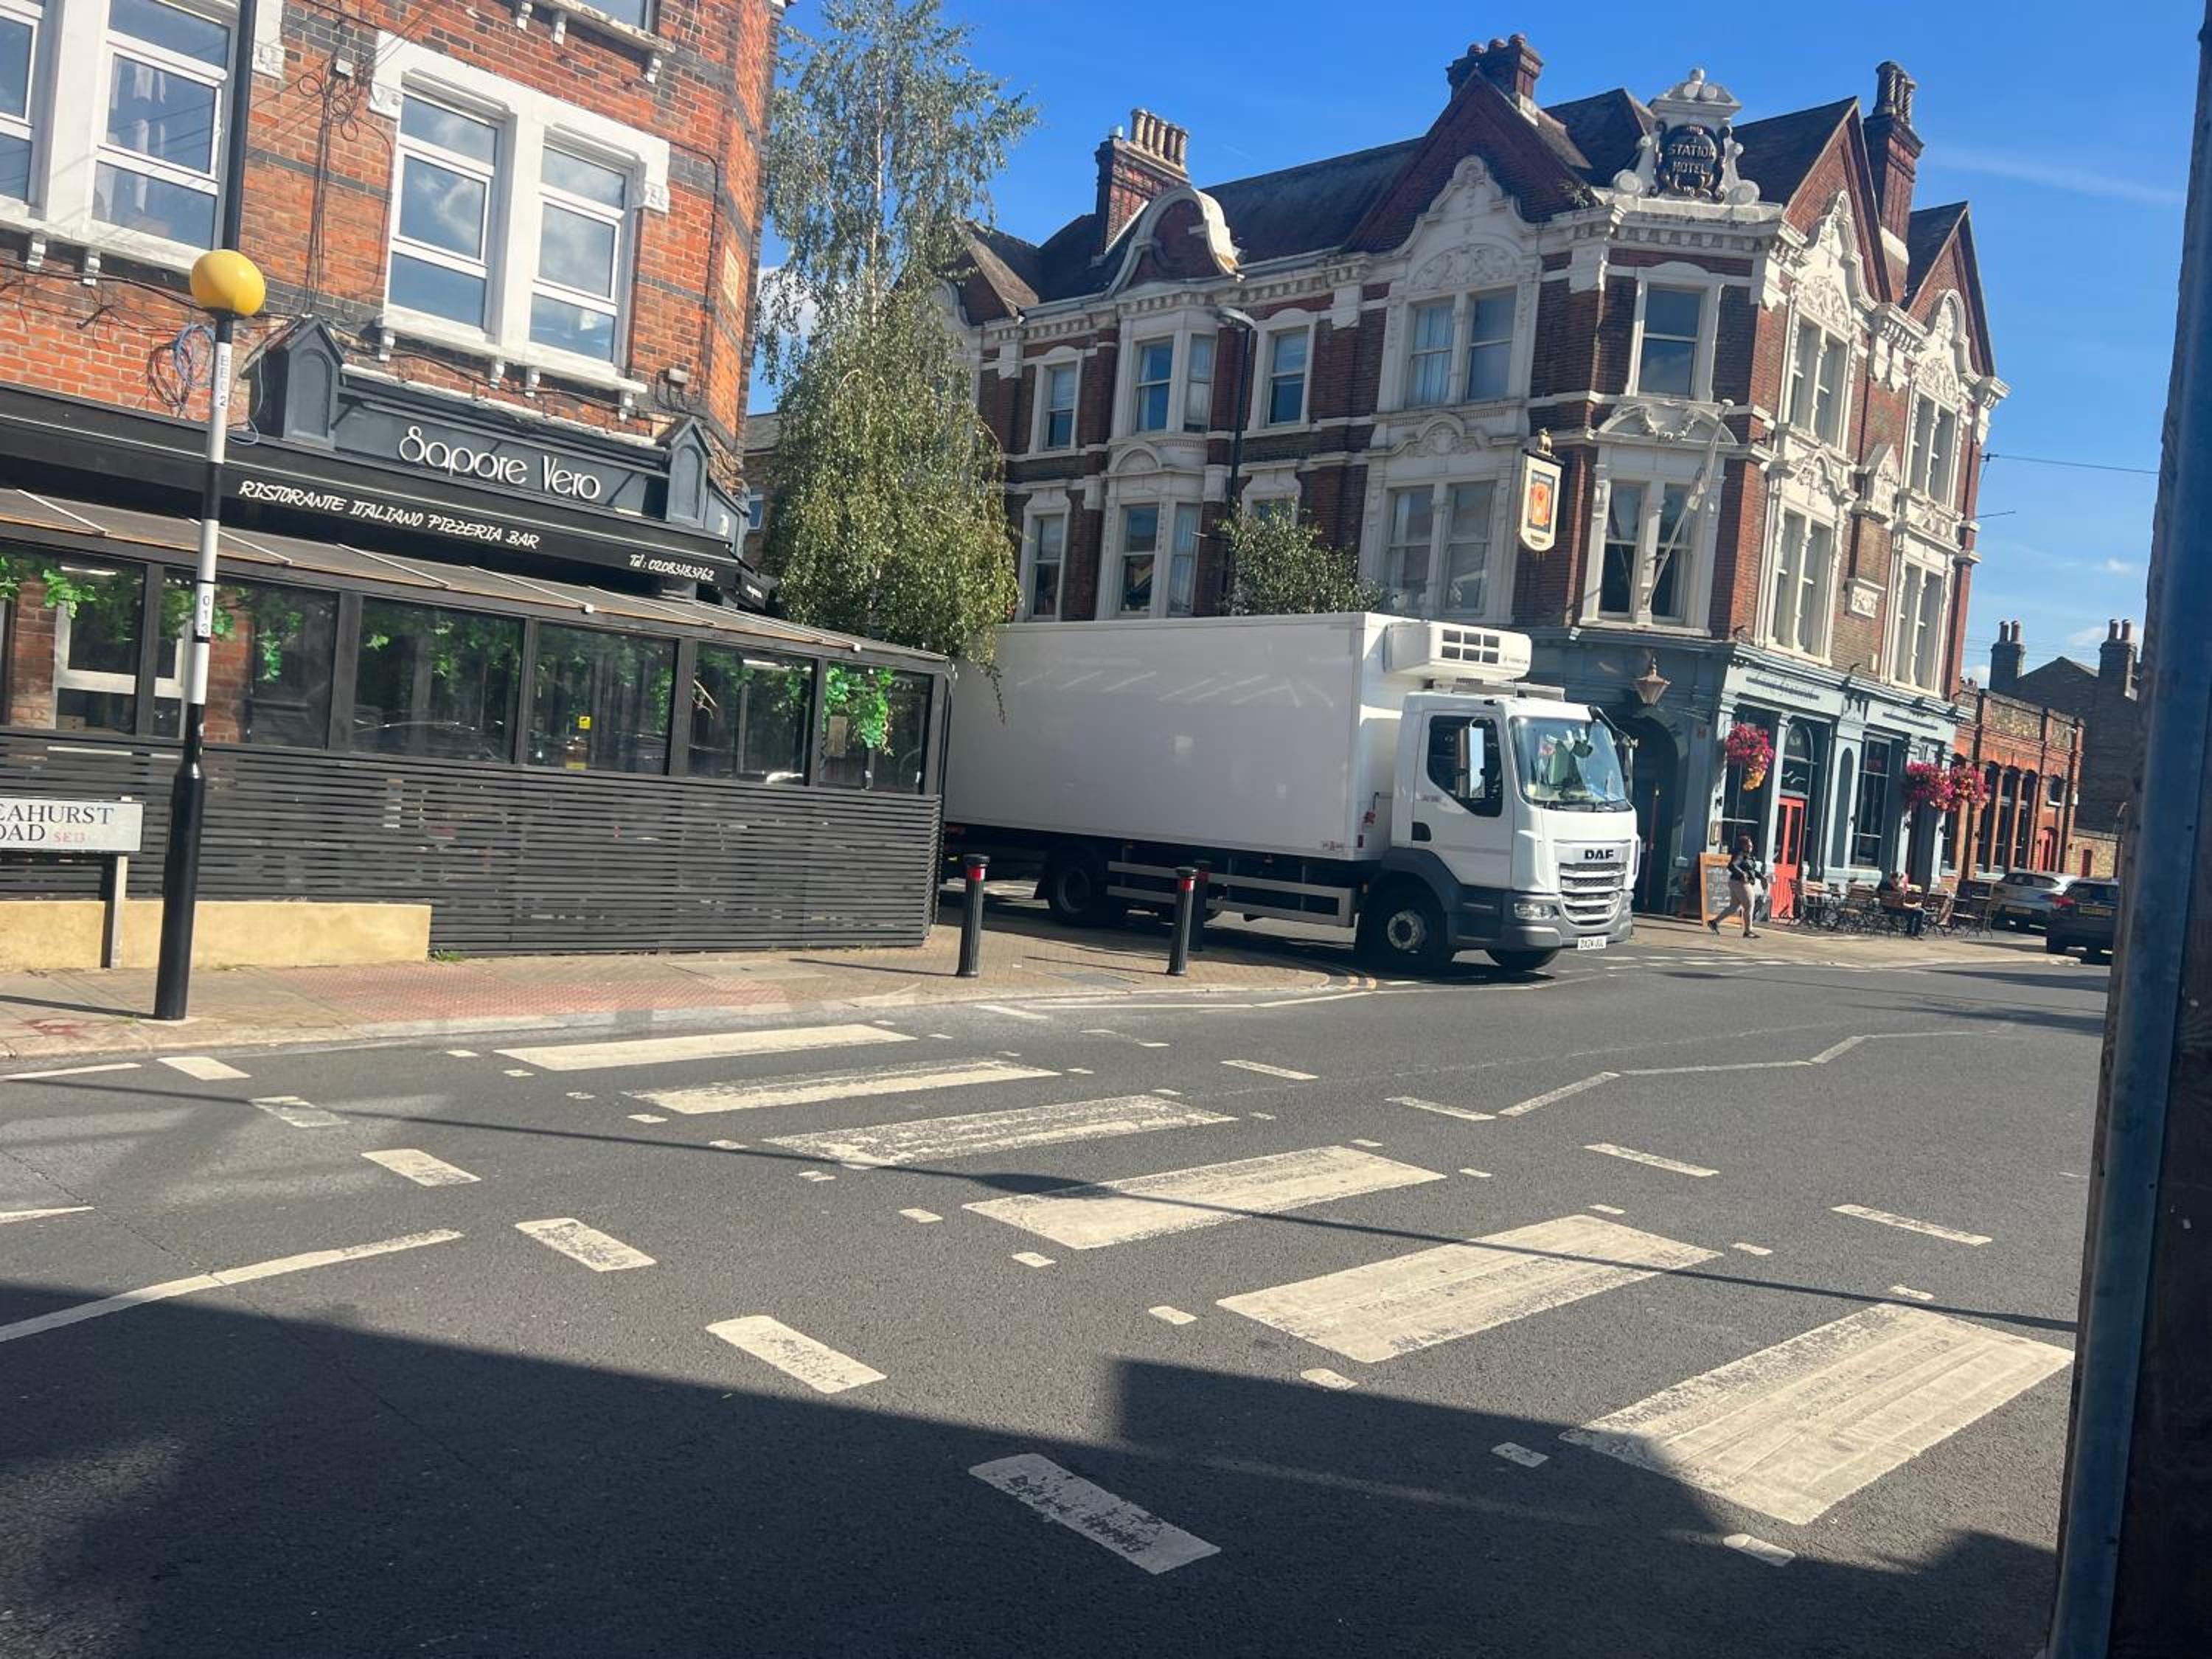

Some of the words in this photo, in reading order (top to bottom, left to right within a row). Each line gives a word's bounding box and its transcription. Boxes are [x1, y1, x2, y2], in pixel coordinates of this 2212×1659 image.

[1672, 161, 1710, 175] HOTEL
[399, 425, 528, 484] Sapore
[543, 454, 601, 500] Vero
[238, 480, 347, 511] RISTORANTE
[349, 501, 424, 527] ITALIANO
[427, 515, 503, 541] PIZZERIA
[505, 530, 540, 549] BAR
[1585, 849, 1614, 859] DAF
